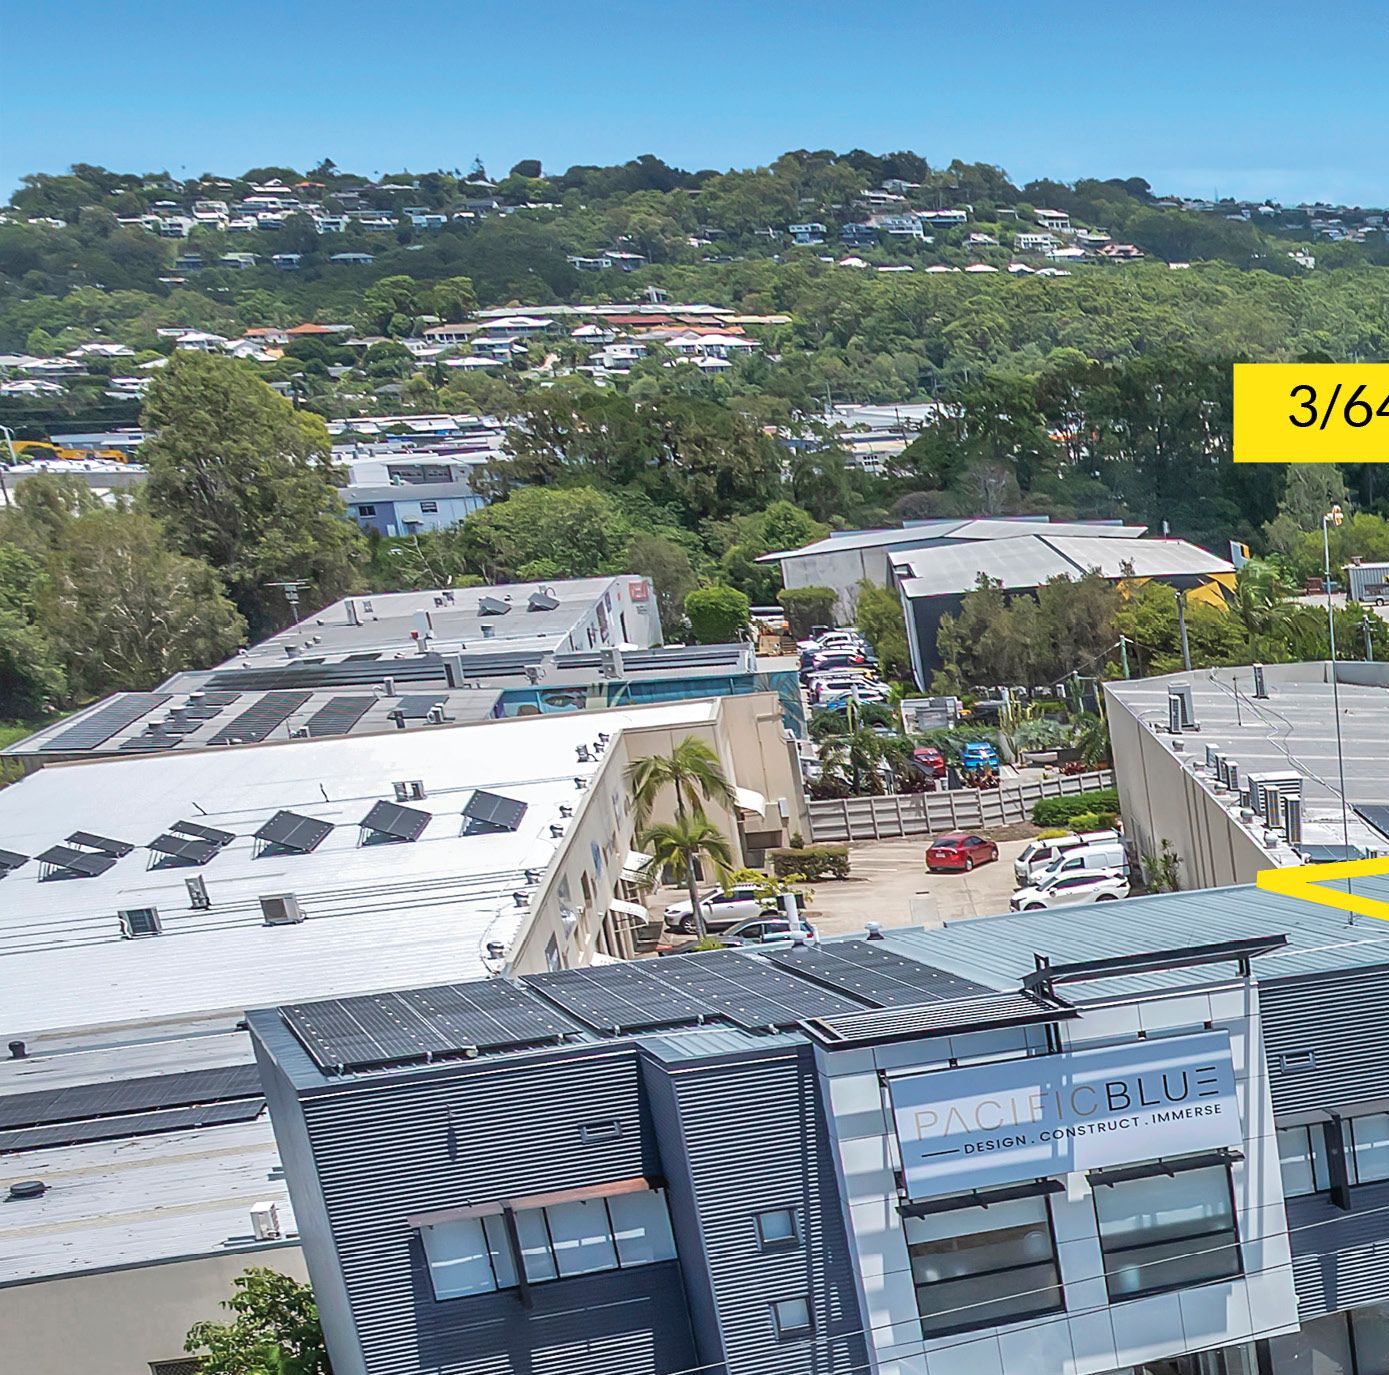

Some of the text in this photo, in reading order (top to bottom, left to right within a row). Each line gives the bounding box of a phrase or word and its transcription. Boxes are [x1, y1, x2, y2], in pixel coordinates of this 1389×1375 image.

[963, 1103, 1222, 1155] DESIGN CONSTRUCT IMMERSE
